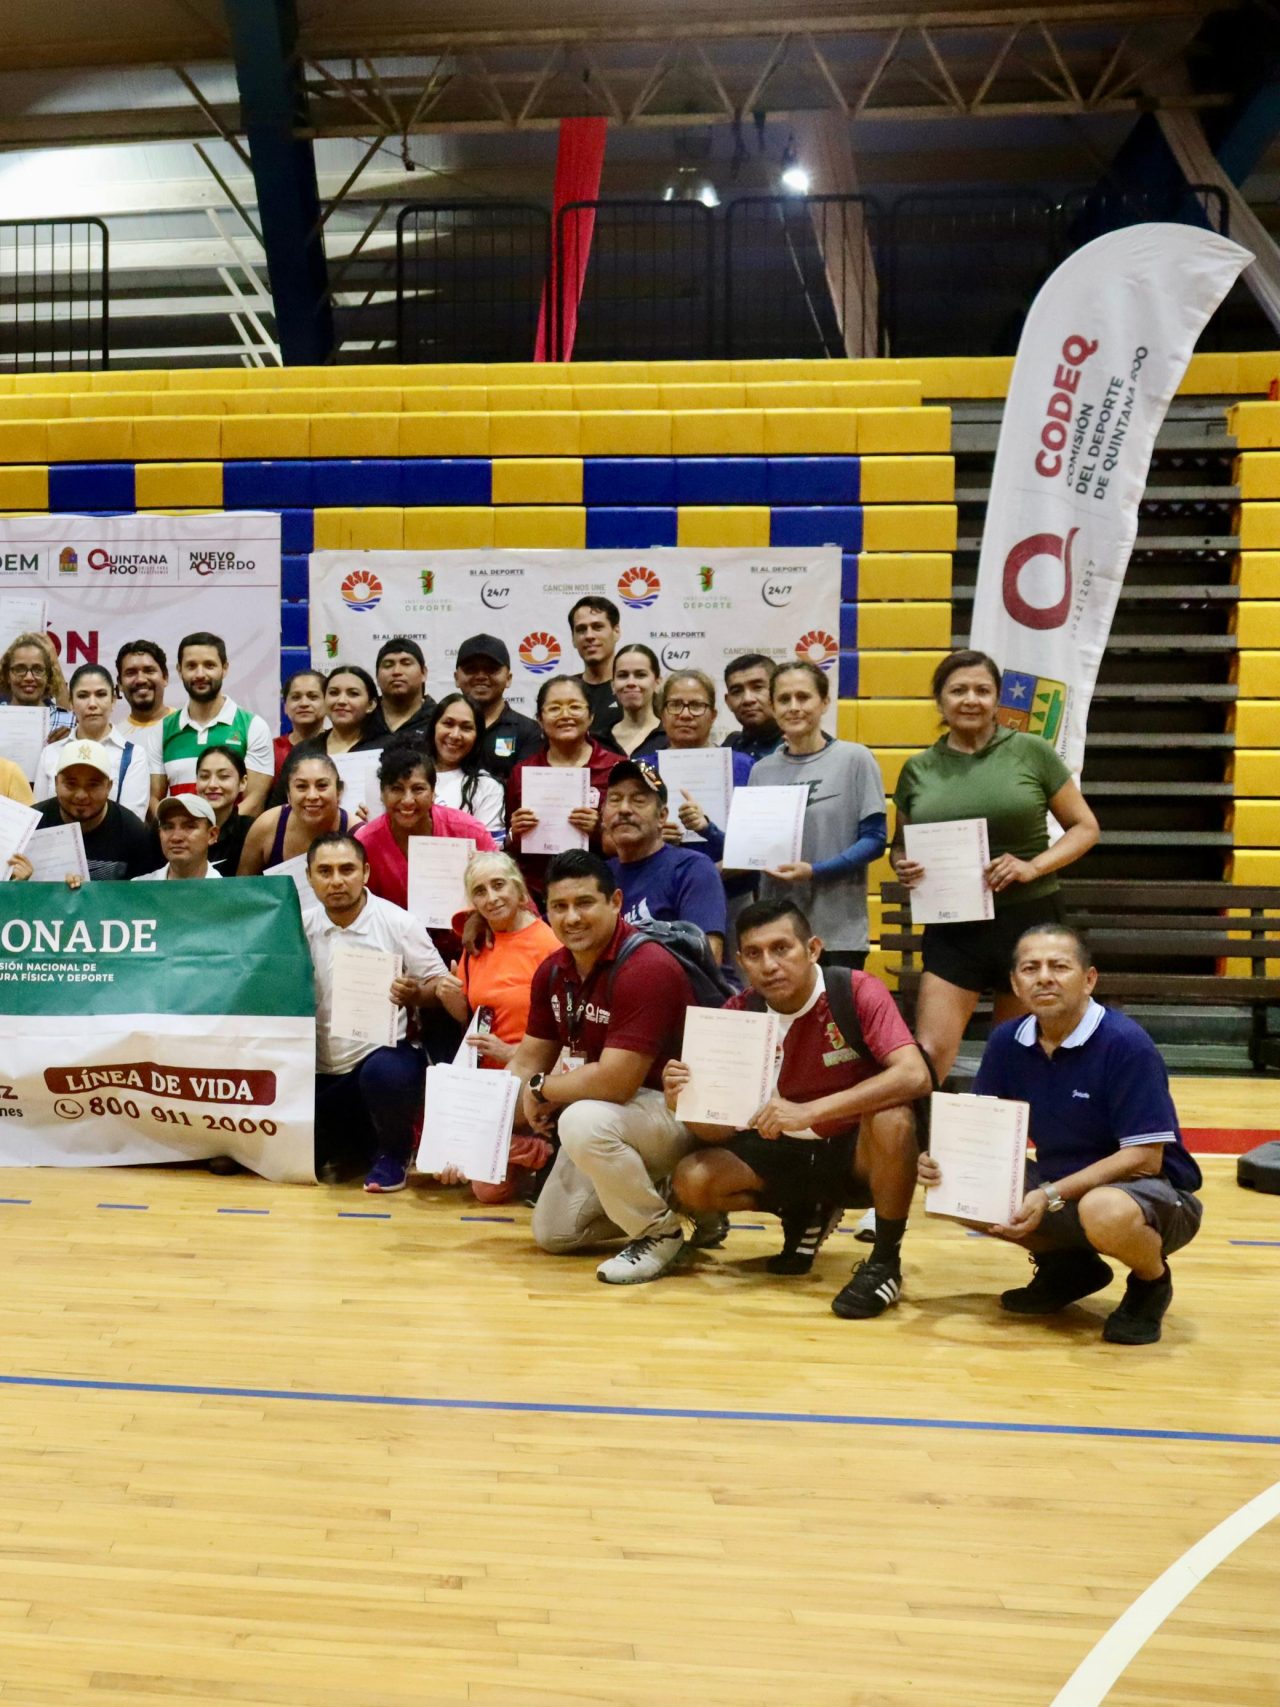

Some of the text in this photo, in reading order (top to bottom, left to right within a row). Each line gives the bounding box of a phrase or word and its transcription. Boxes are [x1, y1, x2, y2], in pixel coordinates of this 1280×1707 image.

[1034, 334, 1099, 478] CODEQ
[1075, 375, 1125, 495] DEL DEPORTE
[1067, 403, 1095, 487] COMISIÓN
[1093, 476, 1110, 500] DE
[1103, 387, 1136, 472] QUINTANA
[87, 548, 168, 571] QUINTANA
[189, 551, 235, 561] NUEVO
[109, 565, 138, 575] ROO
[491, 568, 524, 576] DEPORTE
[772, 566, 807, 574] DEPORTE
[486, 587, 510, 598] 24/7
[768, 585, 792, 596] 24/7
[381, 633, 391, 641] AL
[659, 631, 669, 639] AL
[671, 631, 706, 639] DEPORTE
[667, 650, 690, 660] 24/7
[26, 962, 80, 972] NACIONAL
[82, 963, 96, 972] DE
[21, 970, 55, 982] FÍSICA
[58, 973, 64, 982] Y
[67, 973, 114, 982] DEPORTE
[65, 1069, 254, 1101] LÍNEA DE VIDA
[89, 1096, 278, 1136] 800 911 2000
